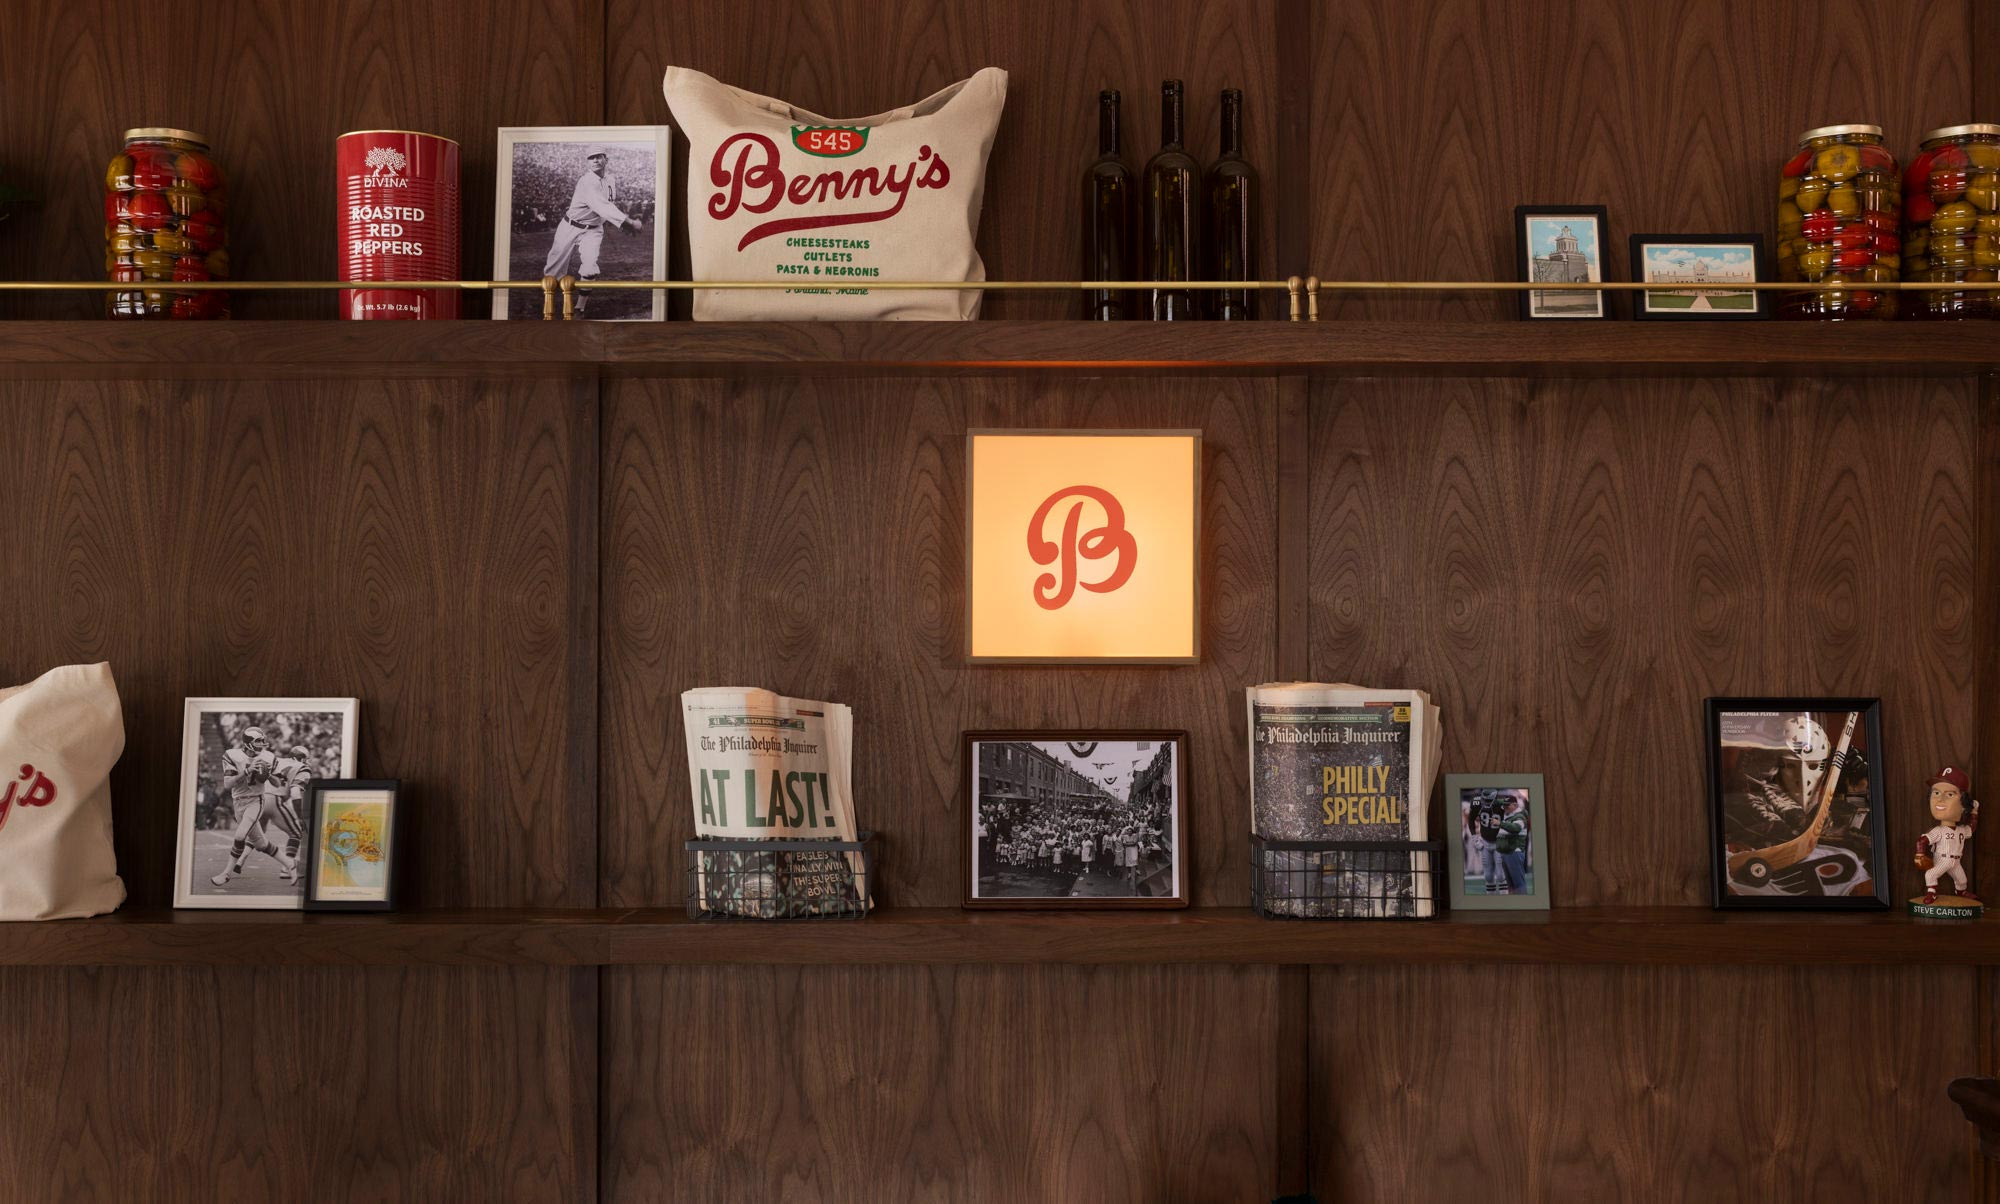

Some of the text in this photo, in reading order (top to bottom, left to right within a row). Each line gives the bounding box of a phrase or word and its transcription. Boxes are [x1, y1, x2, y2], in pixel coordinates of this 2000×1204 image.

[810, 132, 852, 151] 545
[364, 177, 408, 188] DIVINA
[707, 132, 951, 252] Benny's
[352, 206, 425, 222] ROASTED
[369, 223, 404, 237] RED
[353, 240, 423, 256] PEPPERS
[786, 237, 870, 249] CHEESESTEAKS
[803, 251, 853, 262] CUTLETS
[776, 264, 880, 277] PASTA & NEGRONIS
[1027, 485, 1138, 610] B
[1267, 726, 1340, 746] Philadelphia
[1342, 726, 1401, 746] Inquirer
[700, 735, 818, 756] The Philadelphia Inquirer
[1323, 765, 1390, 794] PHILLY
[700, 768, 836, 828] AT LAST!
[1322, 796, 1400, 825] SPECIAL
[1945, 832, 1955, 840] 32
[1913, 905, 1973, 917] STEVE CARLTON
